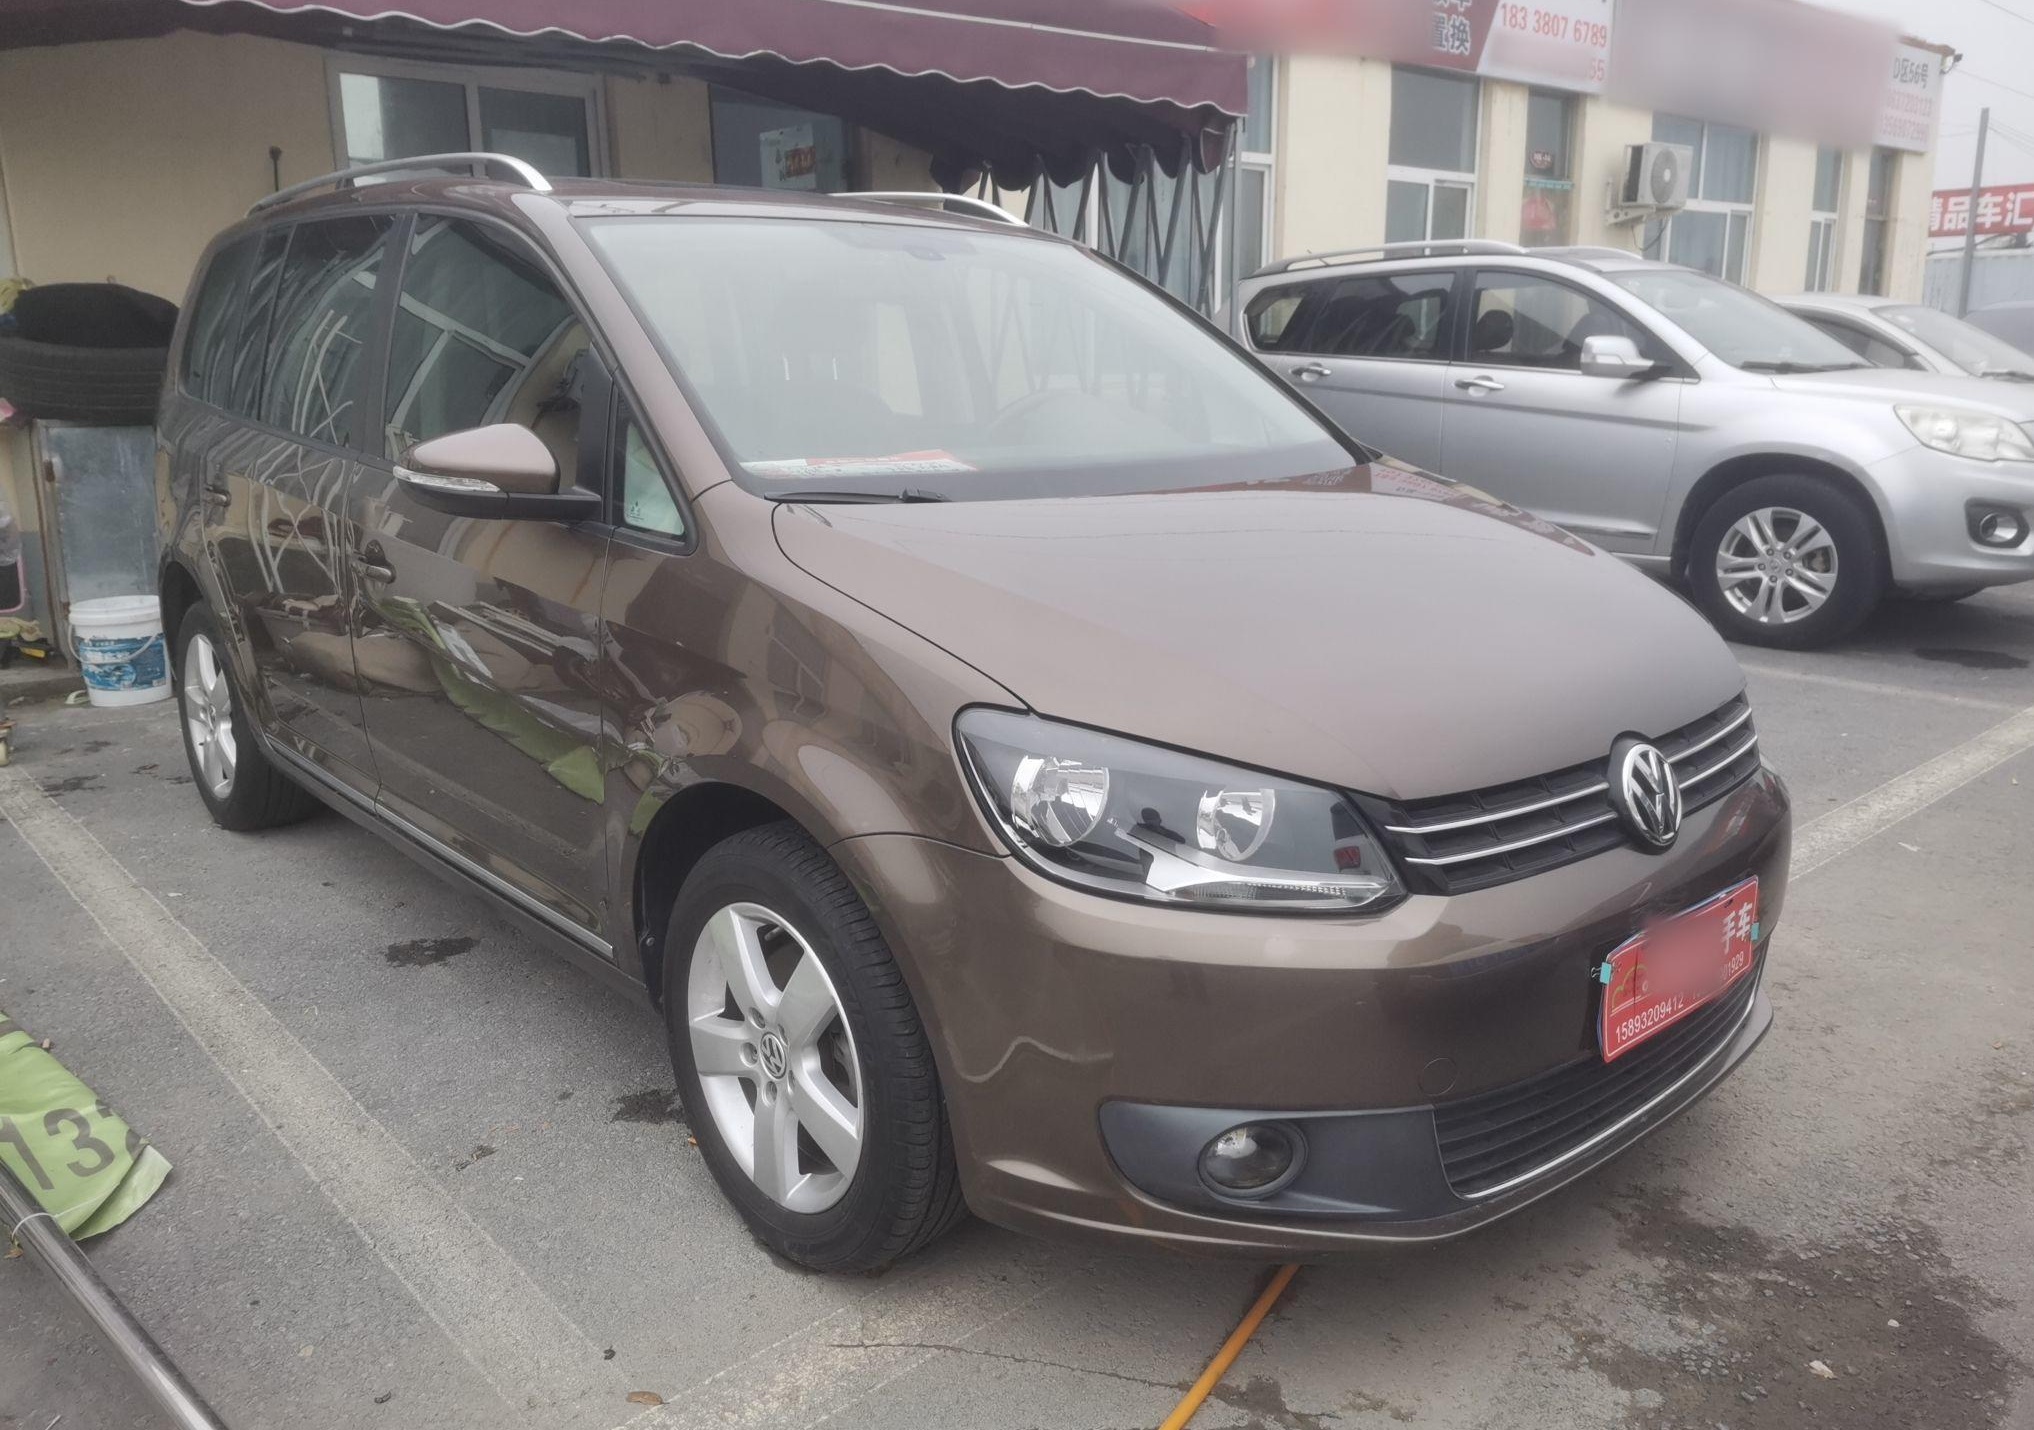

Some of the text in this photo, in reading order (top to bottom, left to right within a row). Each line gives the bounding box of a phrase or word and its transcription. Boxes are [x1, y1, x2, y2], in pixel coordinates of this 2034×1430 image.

[1501, 3, 1527, 31] 183
[1533, 9, 1568, 39] 3807
[1574, 20, 1607, 48] 6789
[1616, 993, 1684, 1043] 15893209412
